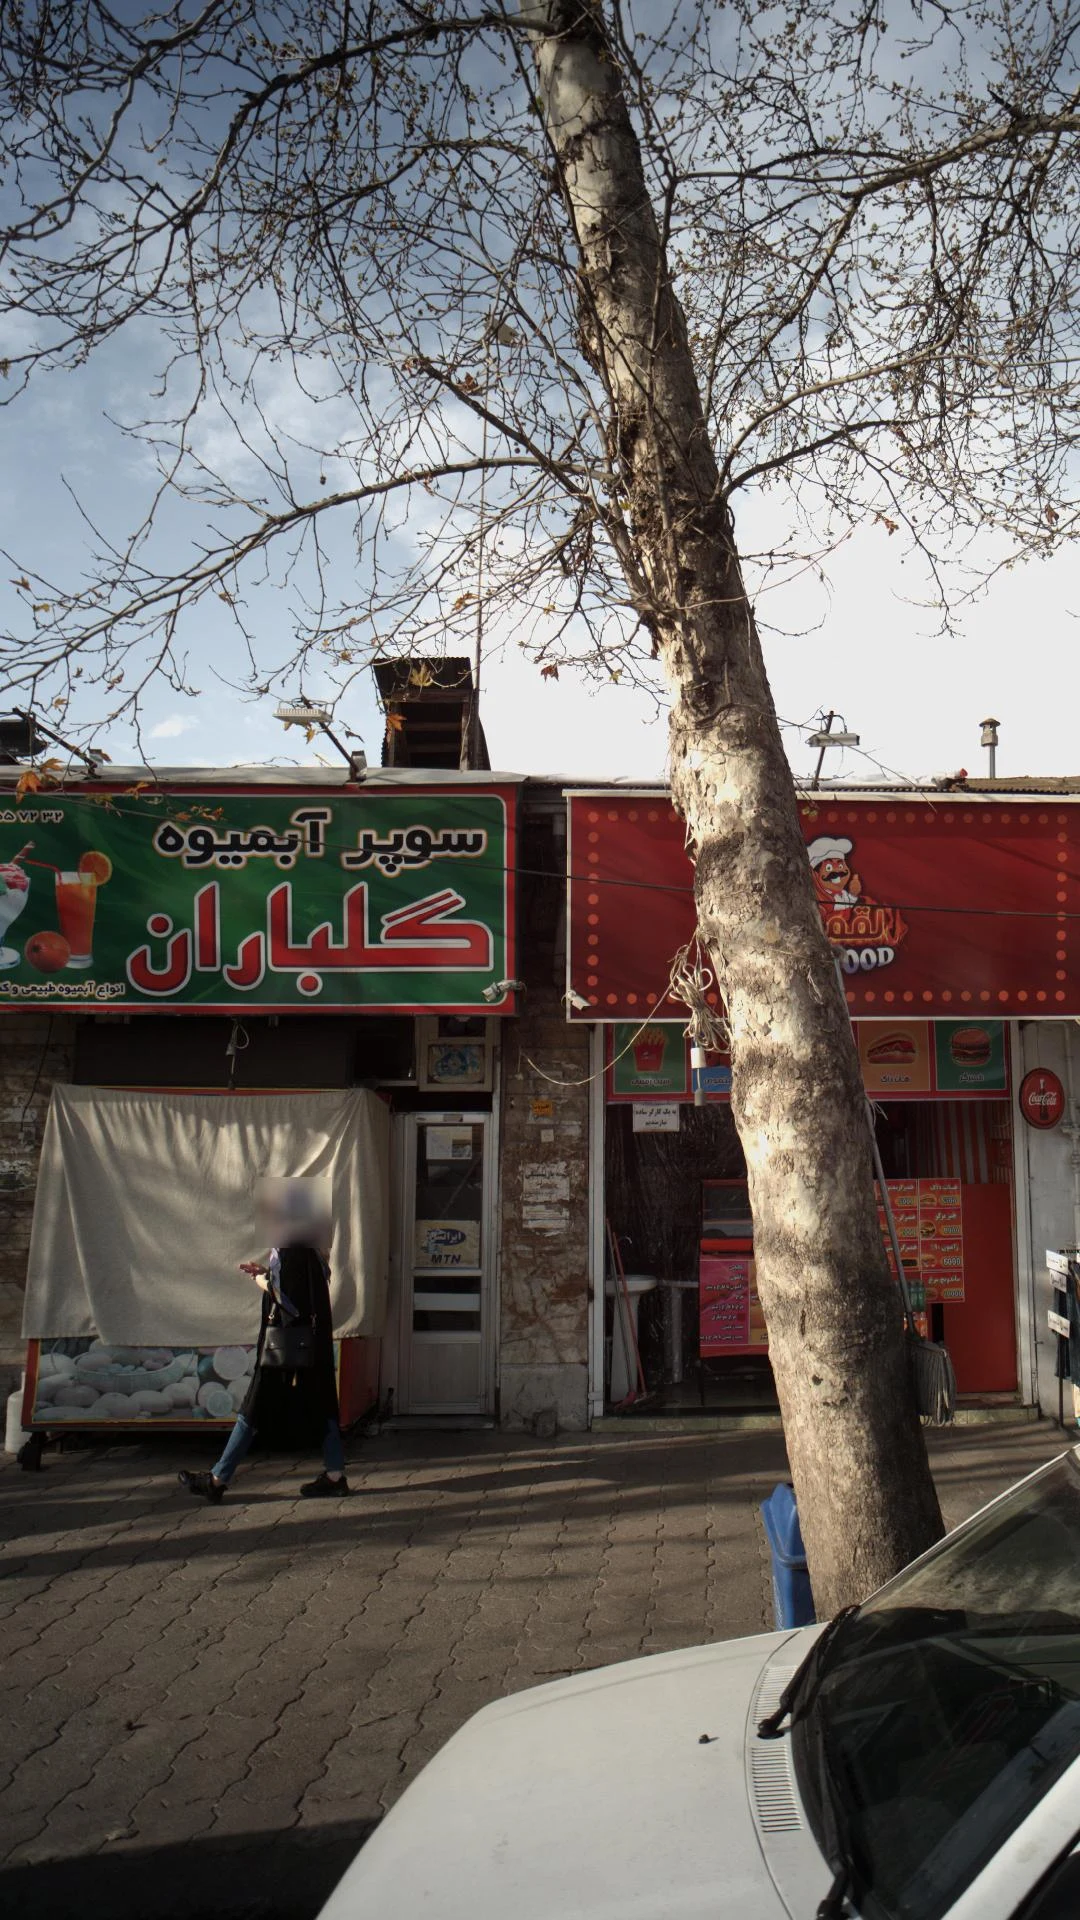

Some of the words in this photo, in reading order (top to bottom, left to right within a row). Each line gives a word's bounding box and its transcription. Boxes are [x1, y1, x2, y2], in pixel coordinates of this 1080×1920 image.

[155, 809, 331, 868] آبمیوه
[342, 823, 487, 877] سوپر
[822, 905, 885, 942] لقم
[127, 882, 493, 996] گلباران
[840, 946, 895, 975] OOD
[21, 982, 57, 997] طبیعی
[57, 980, 96, 997] آبمیوه
[96, 982, 126, 1000] انواع
[431, 1254, 462, 1265] MTN
